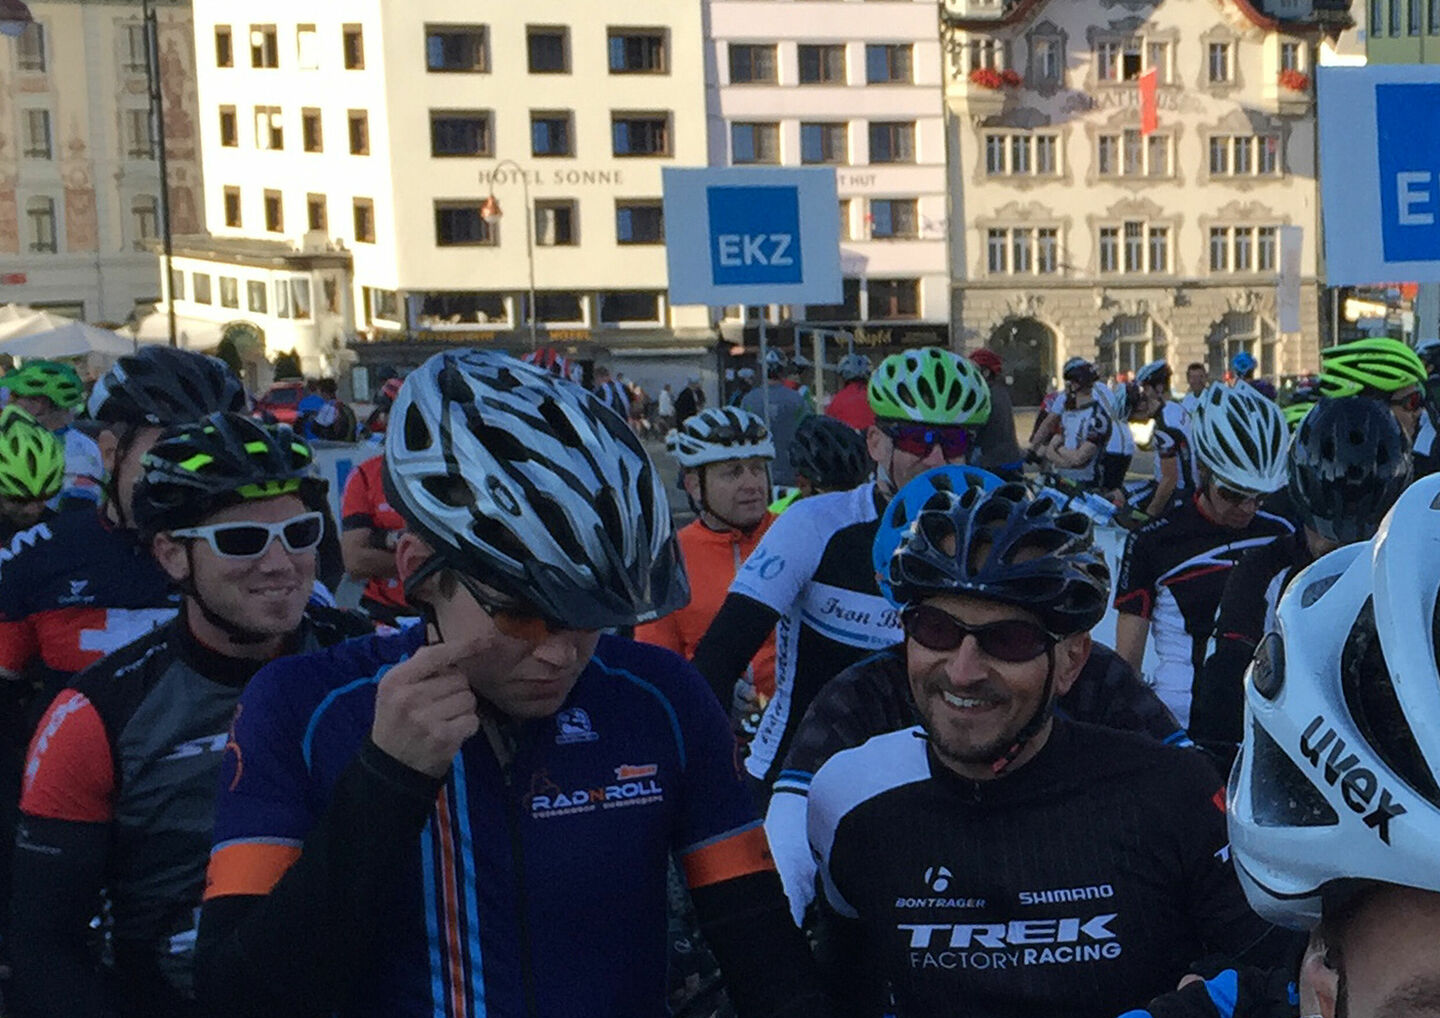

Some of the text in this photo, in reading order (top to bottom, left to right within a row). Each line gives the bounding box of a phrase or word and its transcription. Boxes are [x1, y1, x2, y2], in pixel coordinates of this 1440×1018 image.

[479, 169, 624, 185] HOTEL SONNE
[850, 175, 876, 187] HUT
[718, 233, 794, 267] EKZ
[820, 596, 871, 626] Iron
[1300, 714, 1408, 847] uvex
[895, 896, 987, 909] BONTRAGER
[1018, 882, 1115, 906] SHIMANO
[896, 912, 1119, 949] TREK
[910, 940, 1123, 969] FACTORY RACING
